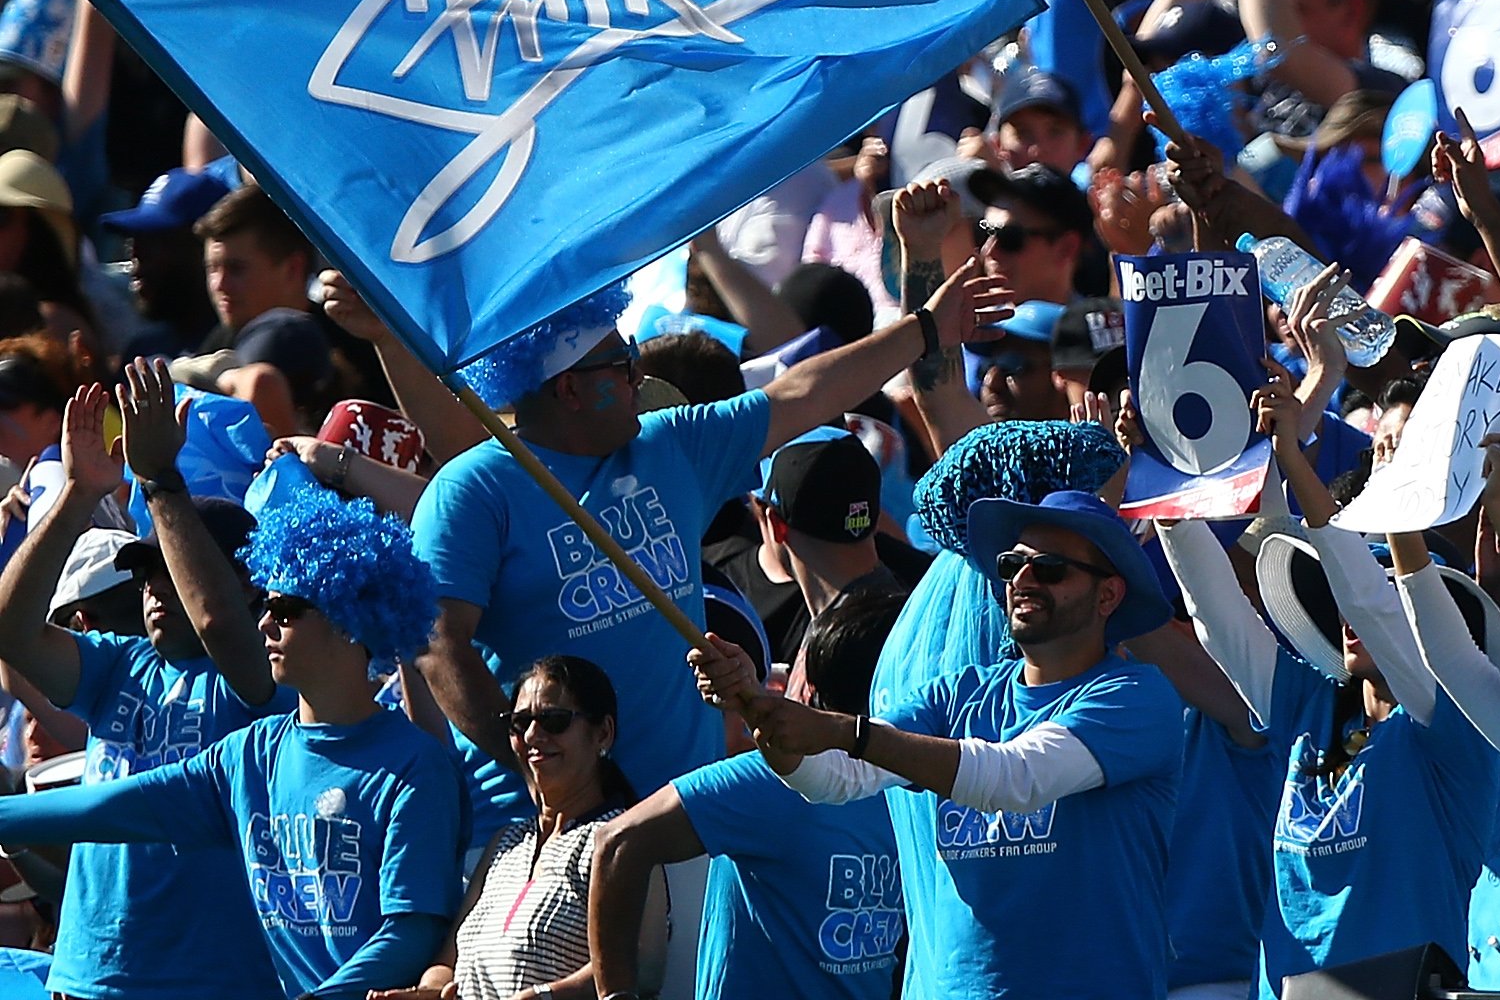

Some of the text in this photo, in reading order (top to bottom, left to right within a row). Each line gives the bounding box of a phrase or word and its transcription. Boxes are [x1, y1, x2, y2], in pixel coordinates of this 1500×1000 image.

[1119, 258, 1249, 302] Weet-Bix
[1138, 302, 1251, 476] 6
[547, 486, 676, 580] BUE
[558, 534, 689, 622] CRW
[568, 615, 615, 640] ADELAIDE
[245, 812, 362, 875] BLUE
[999, 845, 1021, 858] FAN
[1023, 842, 1058, 855] GROUP
[1313, 845, 1333, 858] FAN
[1335, 836, 1367, 853] GROUP
[251, 868, 362, 923] CREW
